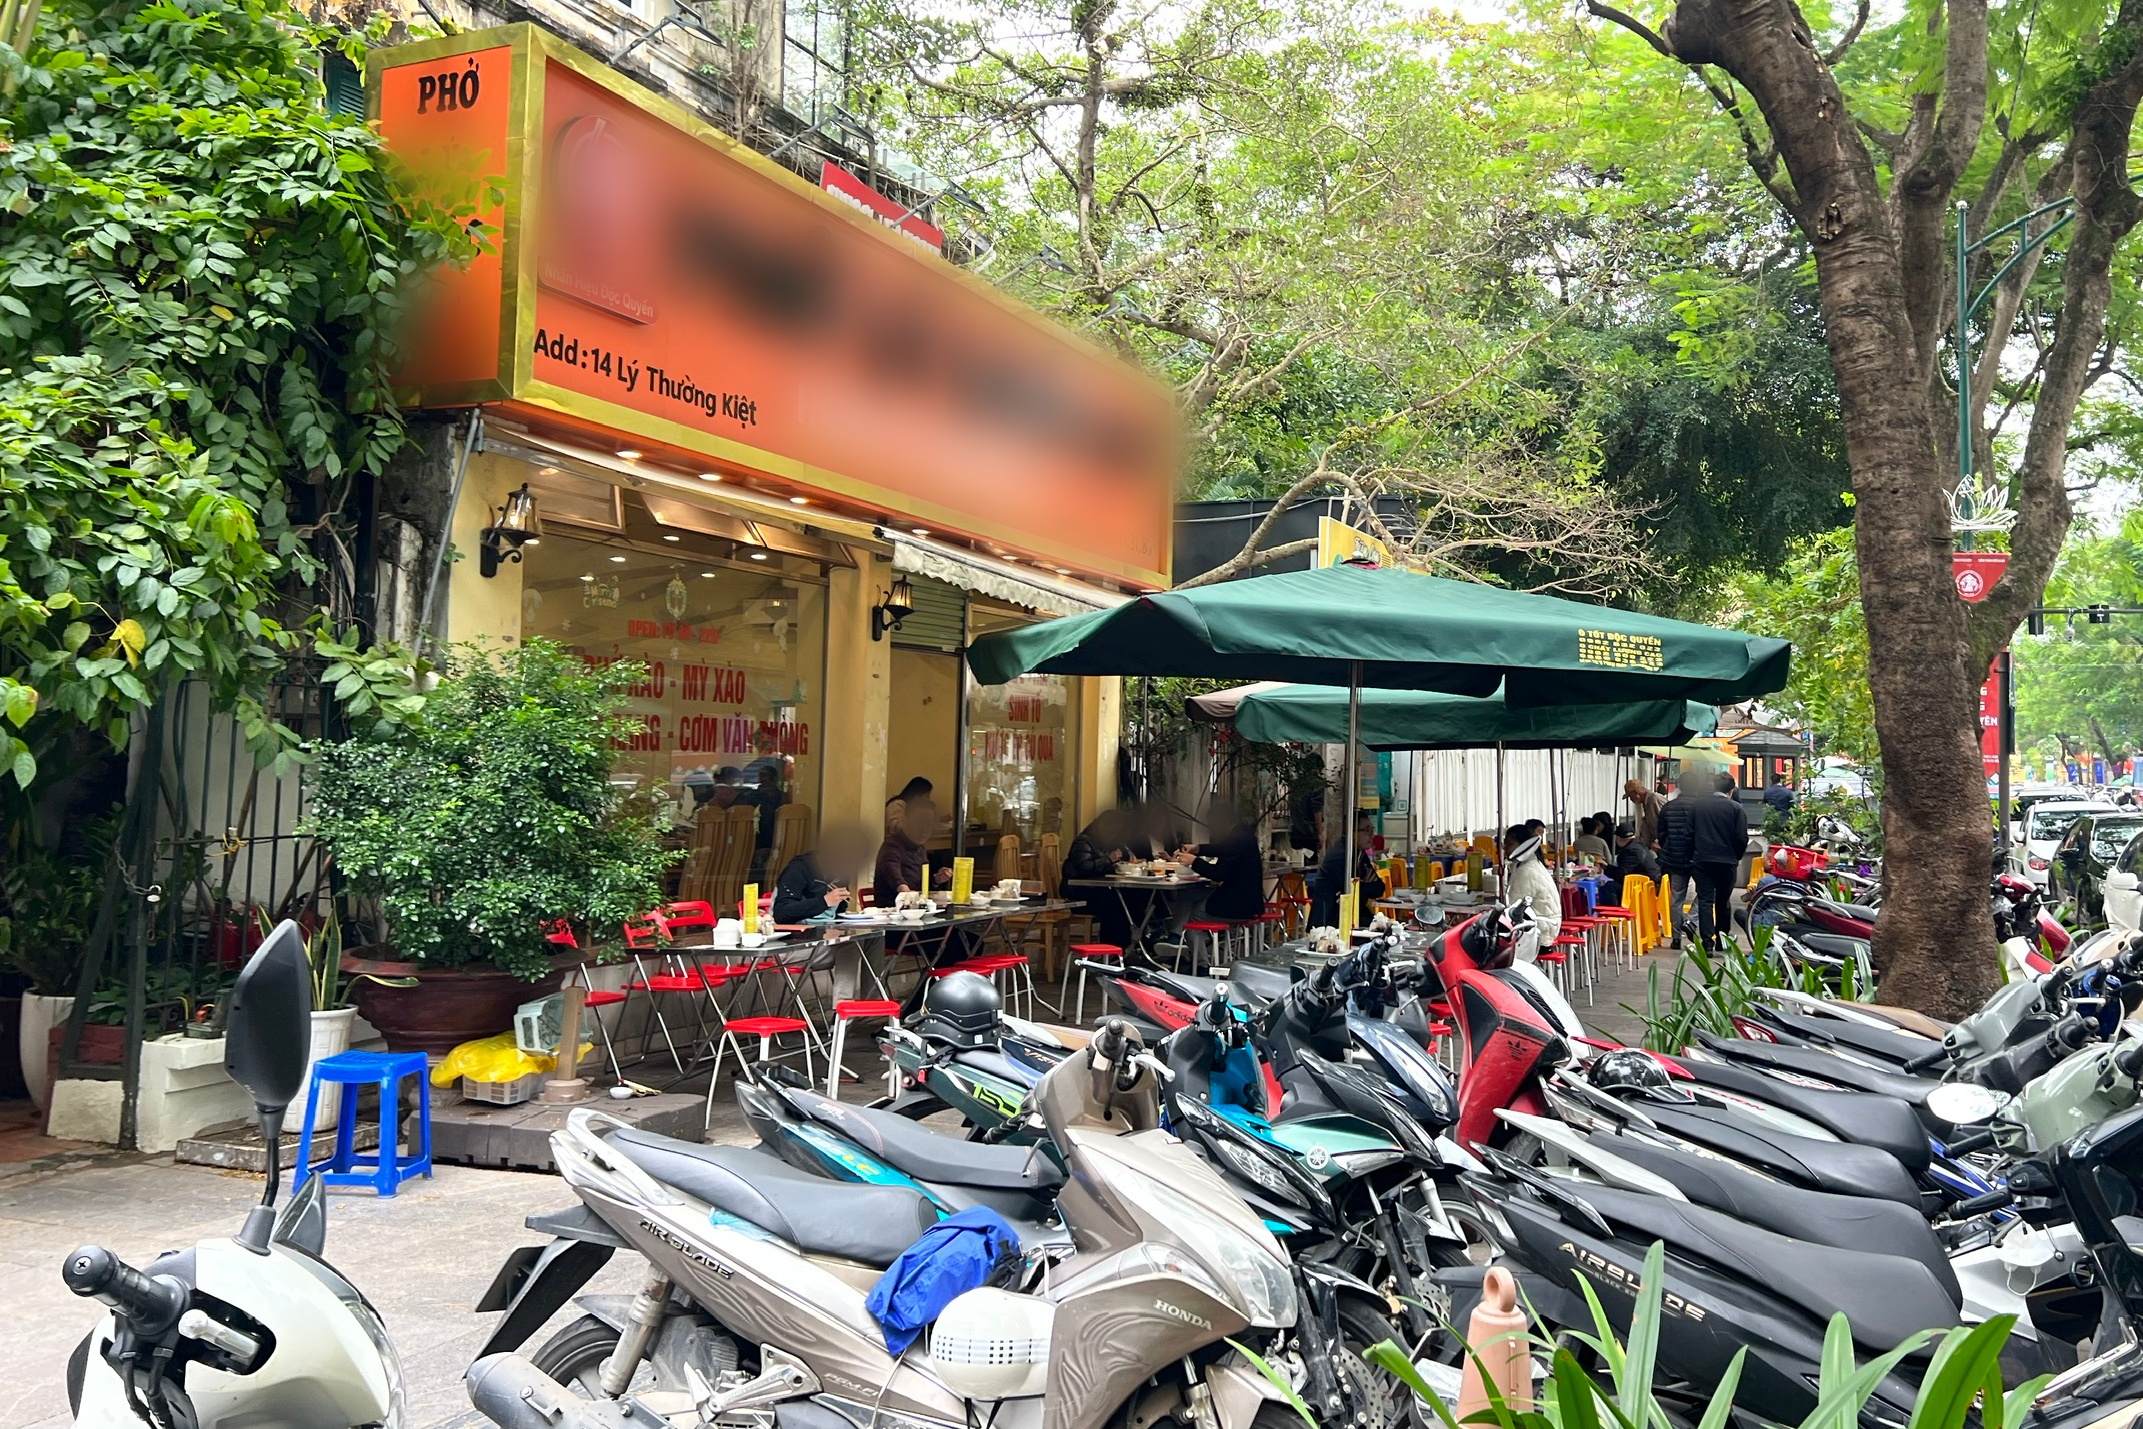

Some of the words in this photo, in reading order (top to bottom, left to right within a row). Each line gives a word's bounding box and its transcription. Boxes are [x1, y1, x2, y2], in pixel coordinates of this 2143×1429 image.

[417, 57, 480, 115] PHỞ
[617, 356, 639, 392] Lý
[646, 366, 717, 418] Thường
[722, 392, 757, 429] Kiệt
[713, 661, 746, 705] XÀO
[679, 714, 718, 753] CƠM
[723, 711, 755, 754] VĂN
[1556, 1241, 1706, 1323] AIRBLDE
[1153, 1298, 1213, 1332] HONDA
